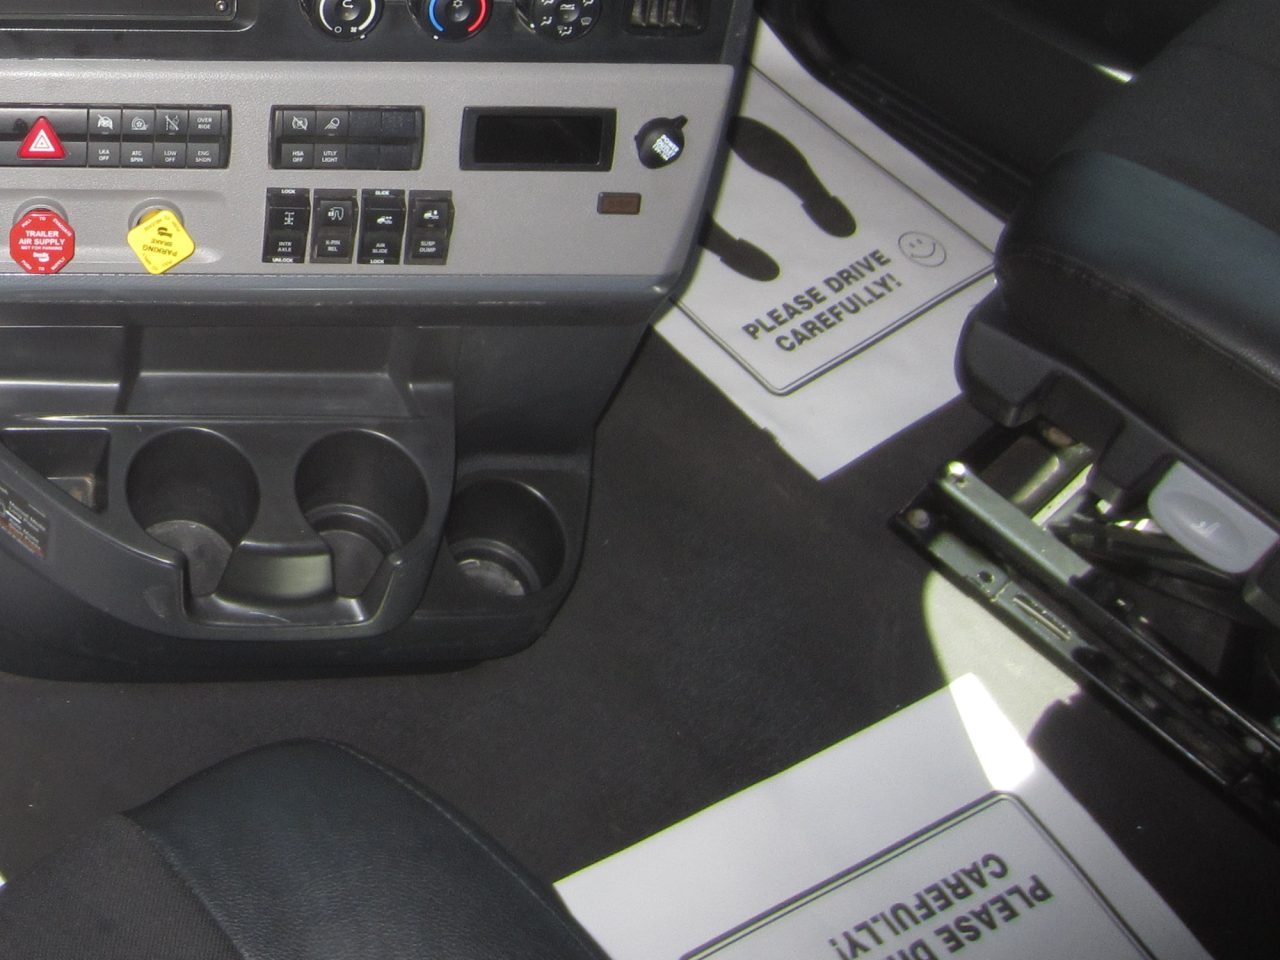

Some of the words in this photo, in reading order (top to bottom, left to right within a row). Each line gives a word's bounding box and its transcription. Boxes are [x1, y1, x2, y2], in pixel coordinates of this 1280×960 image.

[25, 230, 59, 238] TRAILER
[33, 238, 66, 246] SUPPLY
[142, 244, 178, 257] PARKING
[151, 238, 173, 247] BRAKE
[742, 286, 827, 340] PLEASE
[823, 249, 892, 294] DRIVE
[775, 272, 903, 352] CAREFULLY!
[829, 853, 1009, 960] CAREFULLY!
[933, 874, 1054, 954] PLEASE
